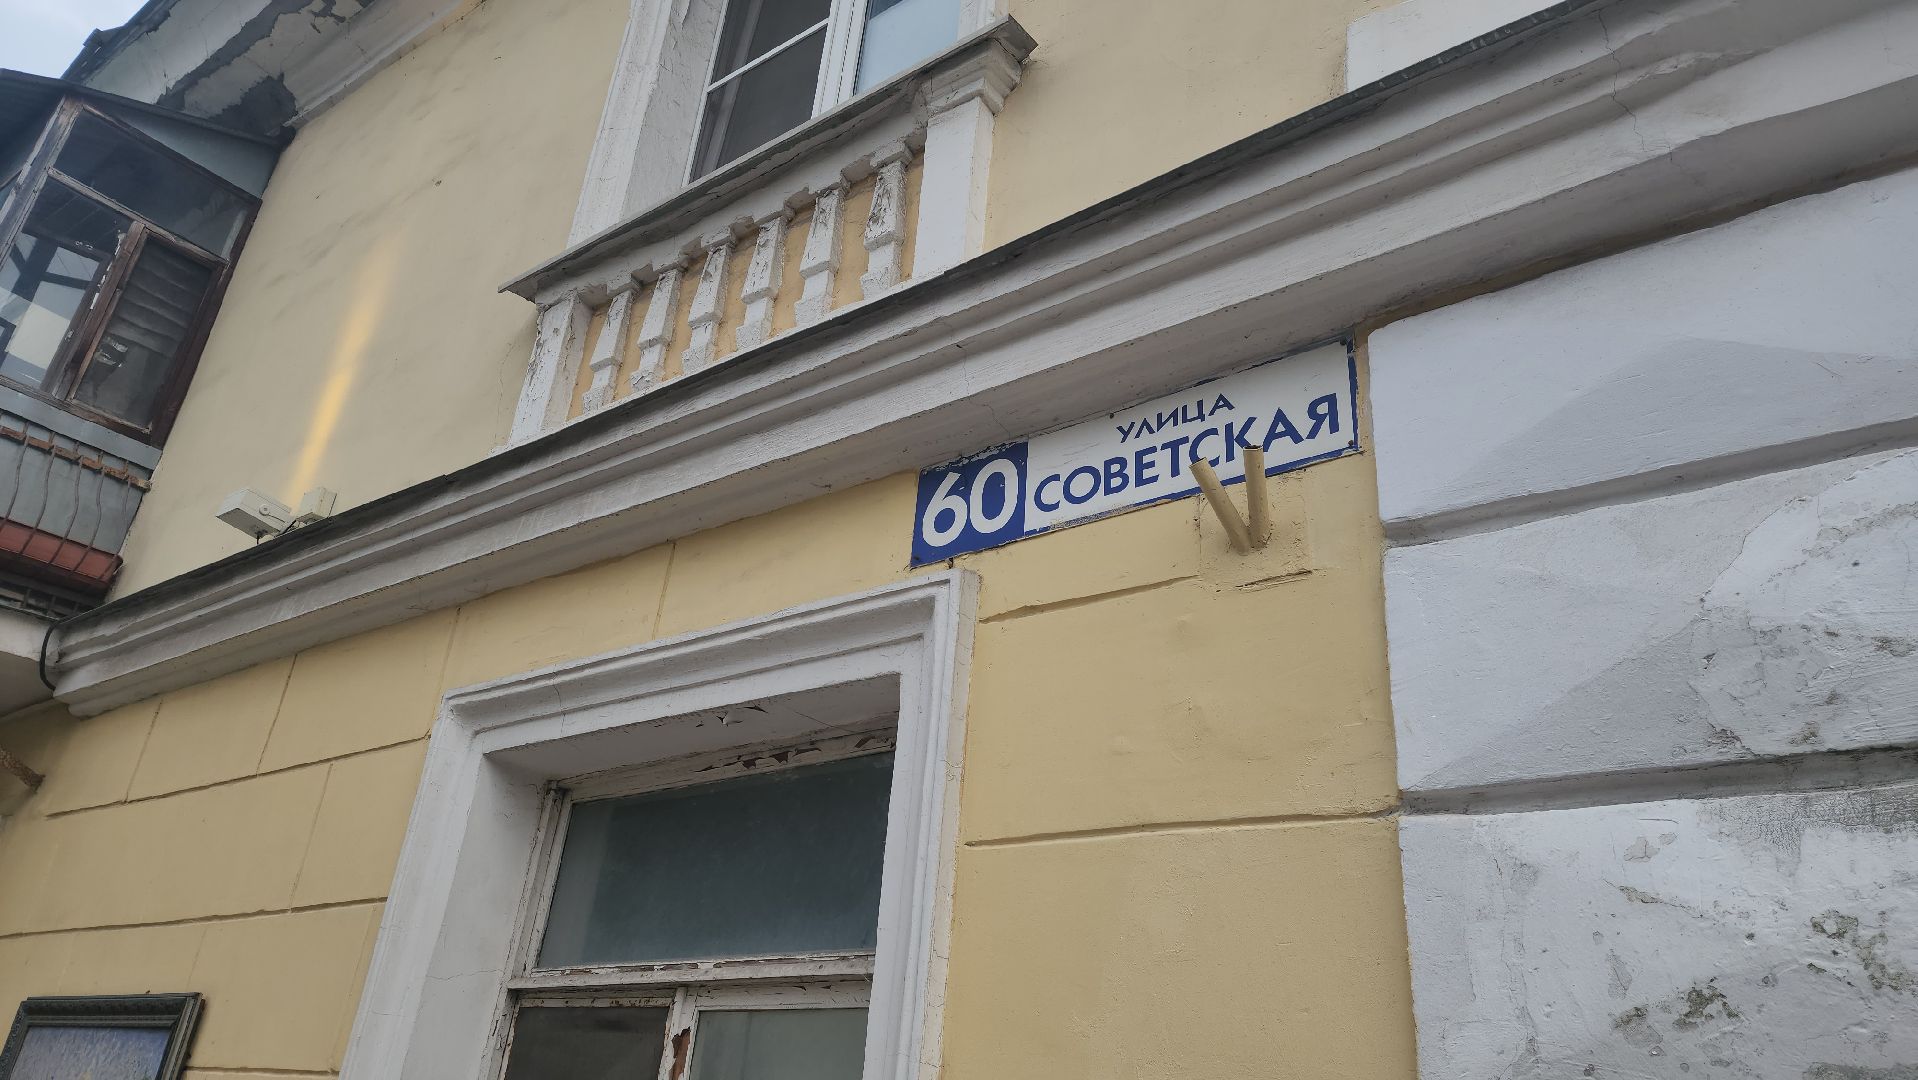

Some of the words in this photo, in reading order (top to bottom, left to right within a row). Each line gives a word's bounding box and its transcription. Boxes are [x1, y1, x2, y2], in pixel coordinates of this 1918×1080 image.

[1034, 393, 1340, 512] СОВЕТСКАЯ
[1117, 393, 1236, 443] УЛИЦА
[922, 458, 1019, 547] 60
